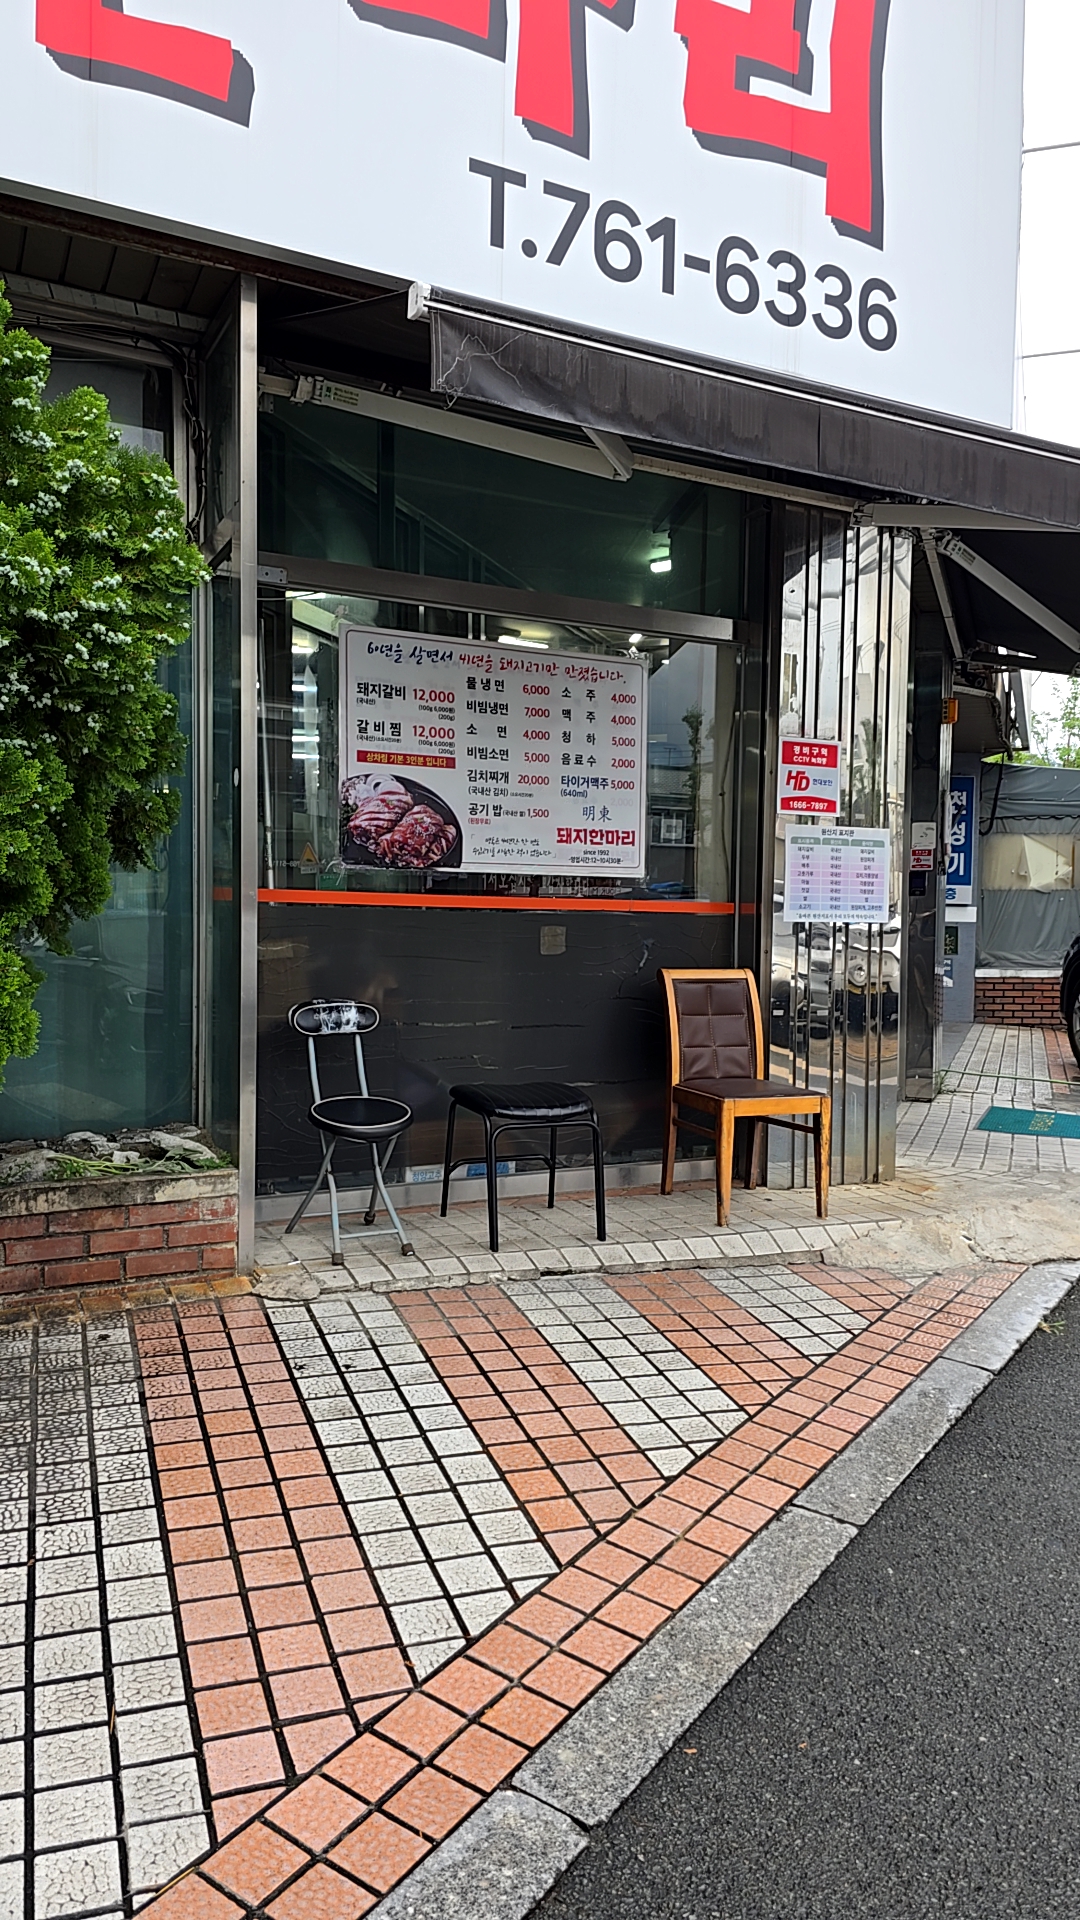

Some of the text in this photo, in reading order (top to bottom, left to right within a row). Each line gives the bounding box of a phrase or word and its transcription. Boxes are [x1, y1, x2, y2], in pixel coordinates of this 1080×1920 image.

[469, 157, 897, 352] T.761-6336
[367, 641, 627, 684] 60년을 살면서 41년을 돼지고기만 만졌습니다.
[356, 682, 455, 703] 돼지갈비 12,000
[522, 684, 550, 696] 6,000
[356, 697, 376, 705] (국내산)
[611, 694, 636, 704] 4,000
[418, 704, 455, 714] (100g 6,000원)
[466, 700, 550, 719] 비빔냉면 7,000
[610, 715, 636, 726] 4,000
[356, 734, 375, 742] (국내산)
[413, 725, 455, 739] 12,000
[523, 730, 550, 742] 4,000
[418, 739, 455, 748] (100g 6,000원)
[612, 736, 636, 748] 5,000
[366, 752, 446, 767] 상차림 기본 3인분 입니다
[466, 746, 550, 764] 비빔소면 5,000
[811, 757, 827, 765] 녹화중
[611, 758, 636, 770] 2,000
[466, 769, 550, 786] 김치찌개 20,000
[560, 775, 635, 791] 타이거맥주 5,000
[812, 778, 833, 786] 현대보안
[468, 786, 492, 797] (국내산
[493, 787, 509, 798] 김치)
[560, 789, 588, 799] (640ml)
[468, 802, 489, 816] 공기
[527, 808, 549, 818] 1,500
[789, 800, 828, 810] 1666-7897
[556, 827, 636, 846] 돼지한마리
